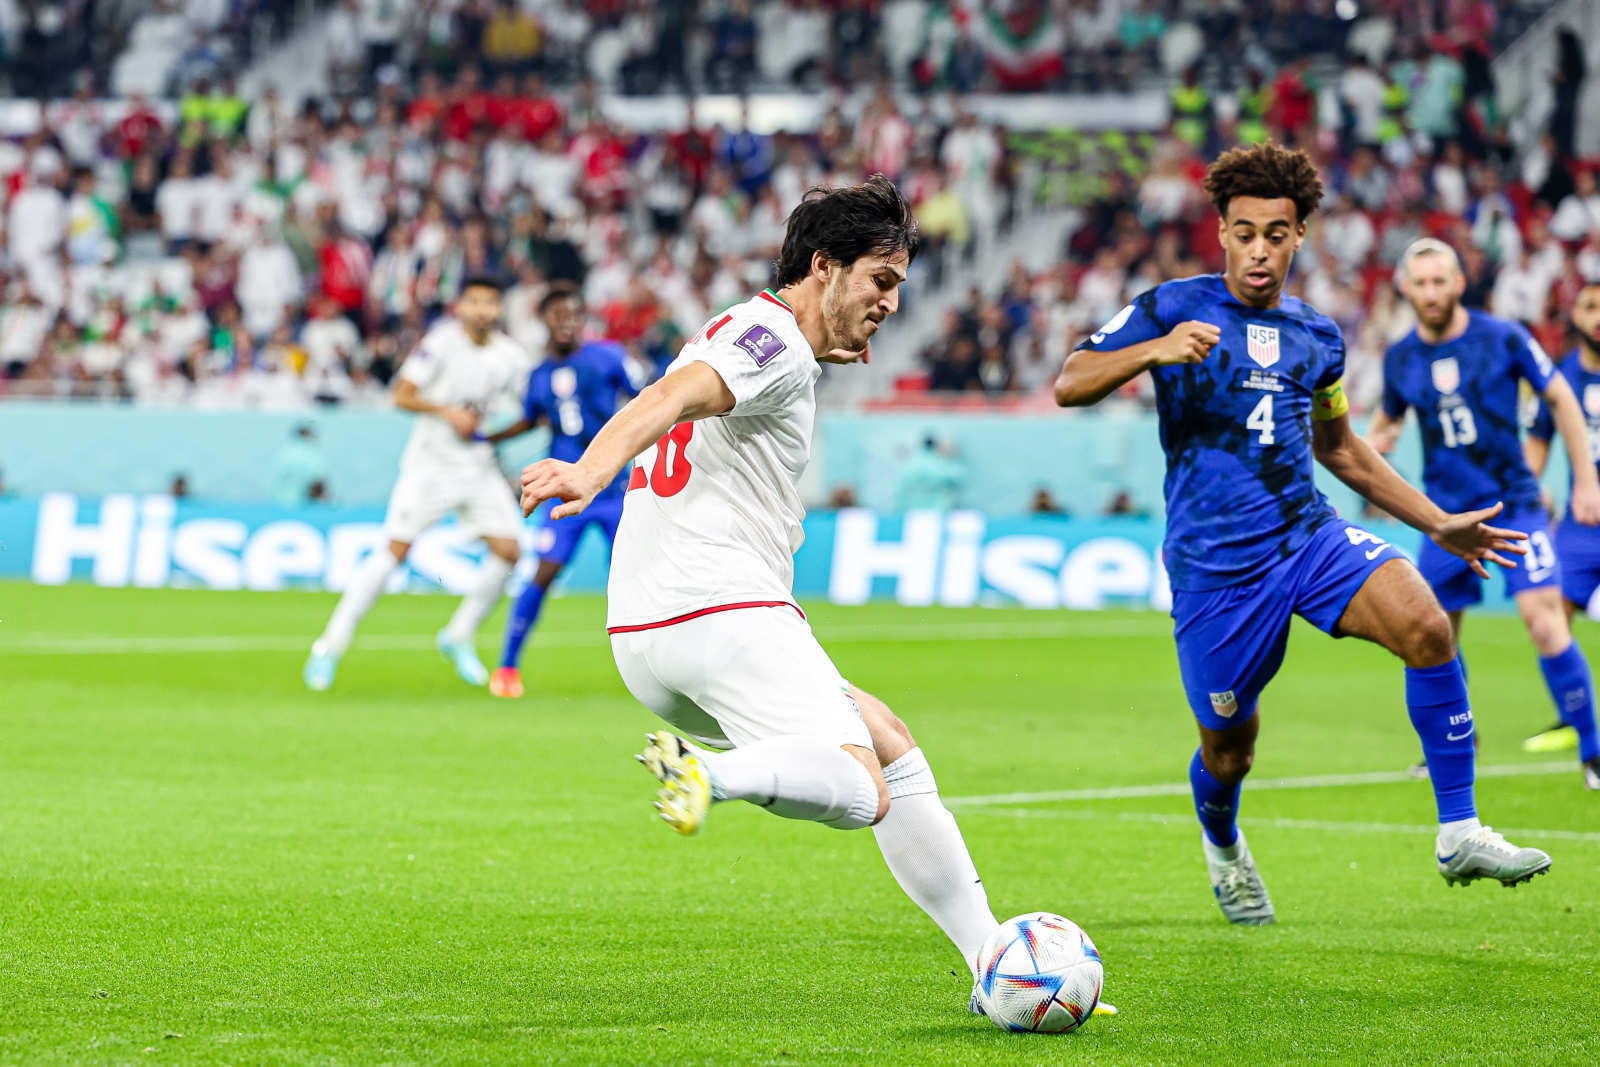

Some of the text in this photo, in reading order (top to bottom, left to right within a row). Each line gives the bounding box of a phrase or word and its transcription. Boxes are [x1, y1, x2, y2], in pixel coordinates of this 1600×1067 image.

[1249, 327, 1277, 344] USA
[1246, 394, 1275, 445] 4
[1438, 407, 1478, 448] 13
[1344, 526, 1385, 545] 4
[1517, 530, 1556, 571] 13
[828, 507, 1172, 611] Hise
